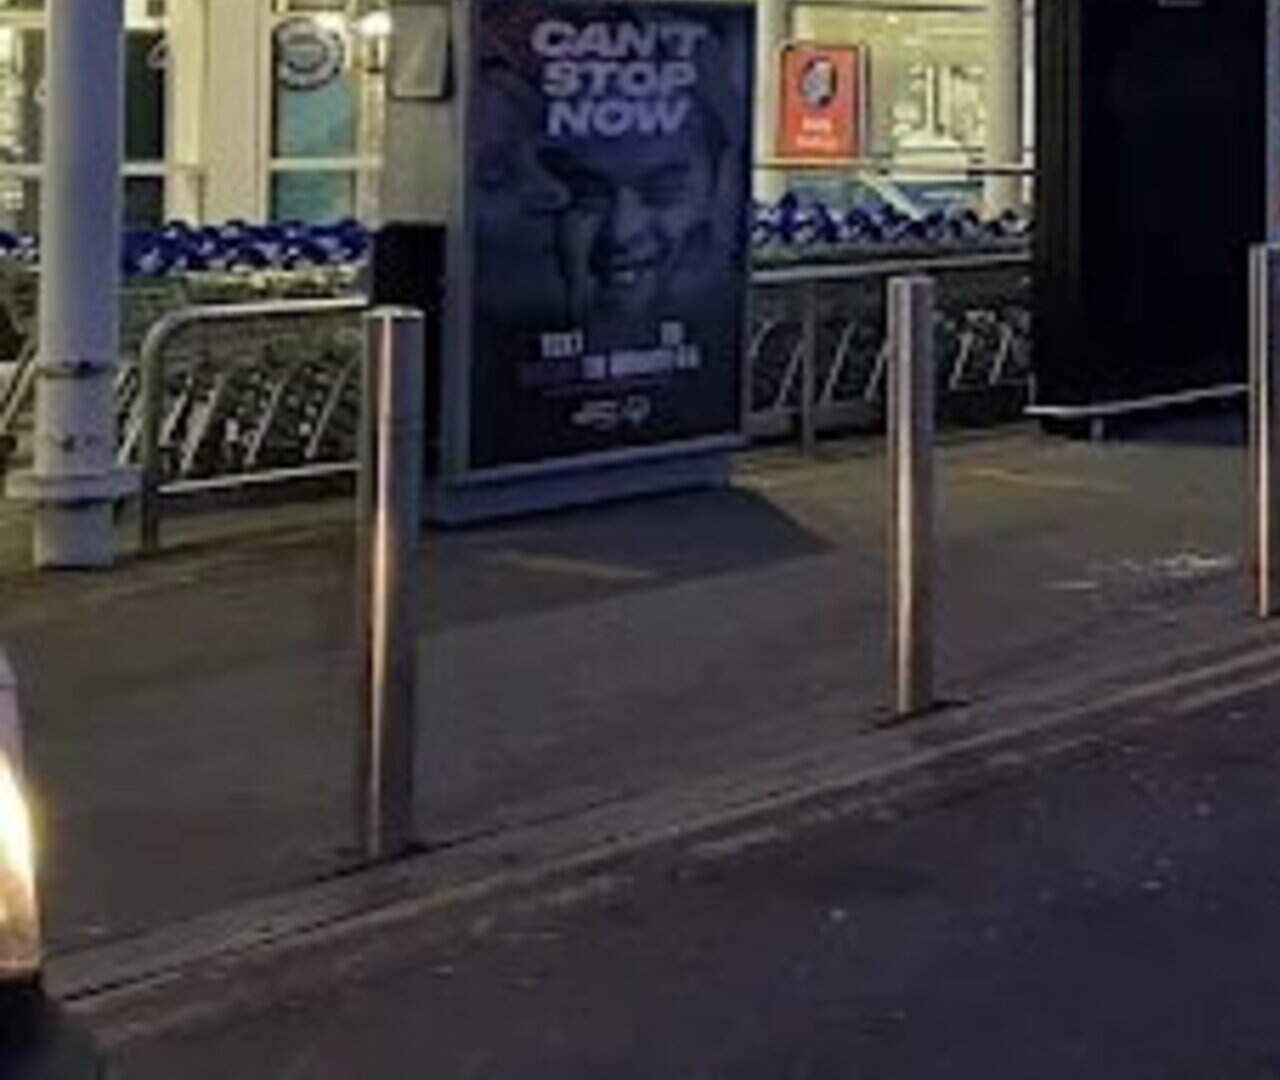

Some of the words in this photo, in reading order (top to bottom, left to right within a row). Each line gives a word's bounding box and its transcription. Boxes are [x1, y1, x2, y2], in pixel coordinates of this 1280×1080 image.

[531, 20, 707, 57] CAN'T
[543, 60, 697, 97] STOP
[547, 98, 692, 137] NOW
